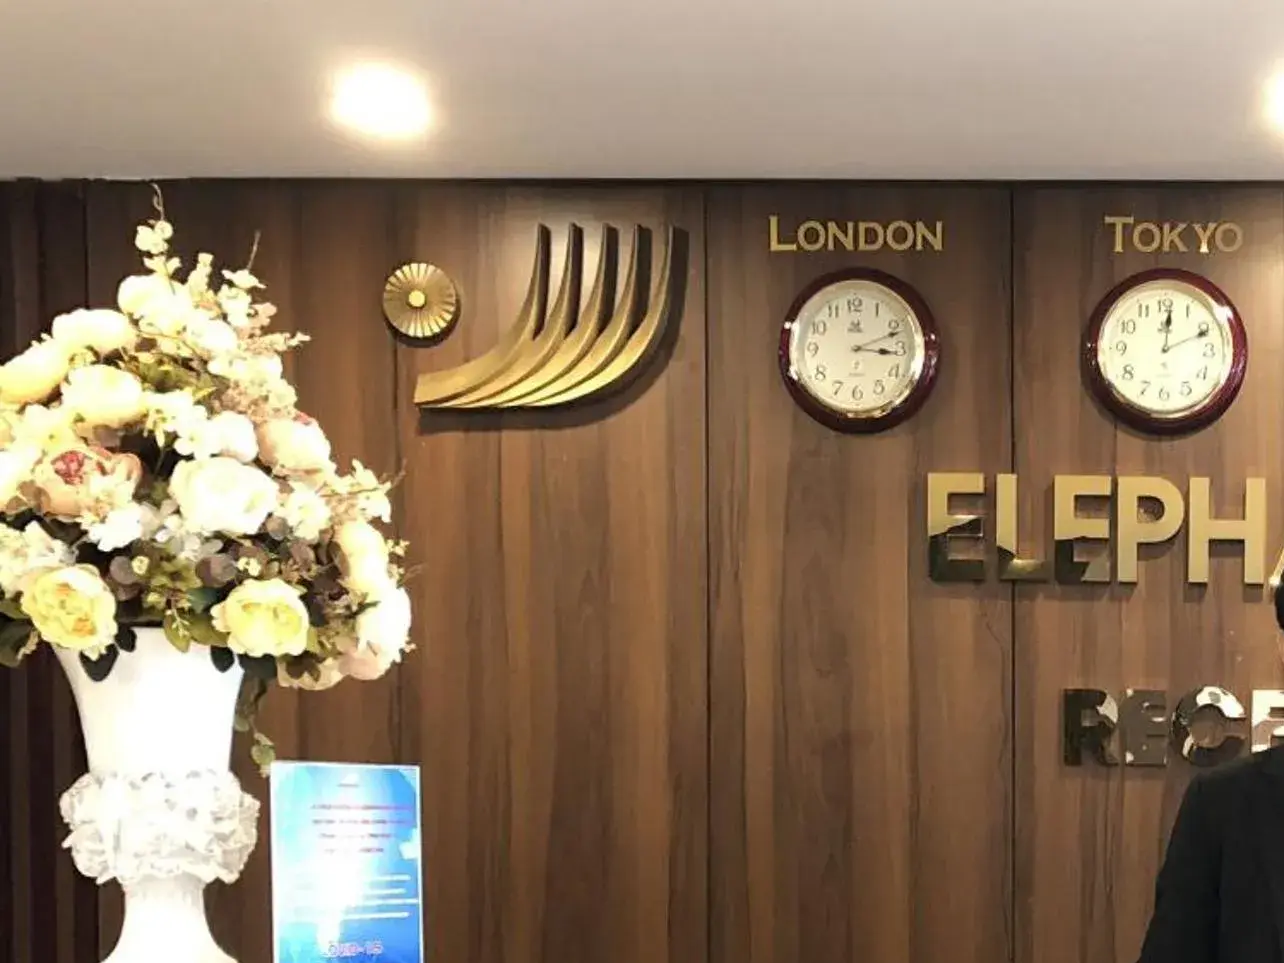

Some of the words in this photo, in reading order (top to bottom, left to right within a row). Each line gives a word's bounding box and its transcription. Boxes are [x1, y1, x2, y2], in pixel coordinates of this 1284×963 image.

[767, 215, 944, 252] LONDON
[1104, 214, 1244, 253] TOKYO
[827, 303, 840, 319] 11
[1137, 303, 1150, 318] 11
[811, 320, 827, 336] 10
[1120, 319, 1136, 335] 10
[806, 341, 820, 358] 9
[1115, 340, 1128, 357] 9
[1202, 342, 1216, 359] 3
[814, 364, 827, 381] 8
[888, 363, 901, 380] 4
[1121, 364, 1135, 381] 8
[1195, 365, 1209, 381] 4
[831, 380, 844, 396] 7
[851, 384, 864, 401] 6
[872, 379, 886, 395] 5
[1139, 380, 1151, 396] 7
[1158, 386, 1170, 402] 6
[1179, 380, 1193, 397] 5
